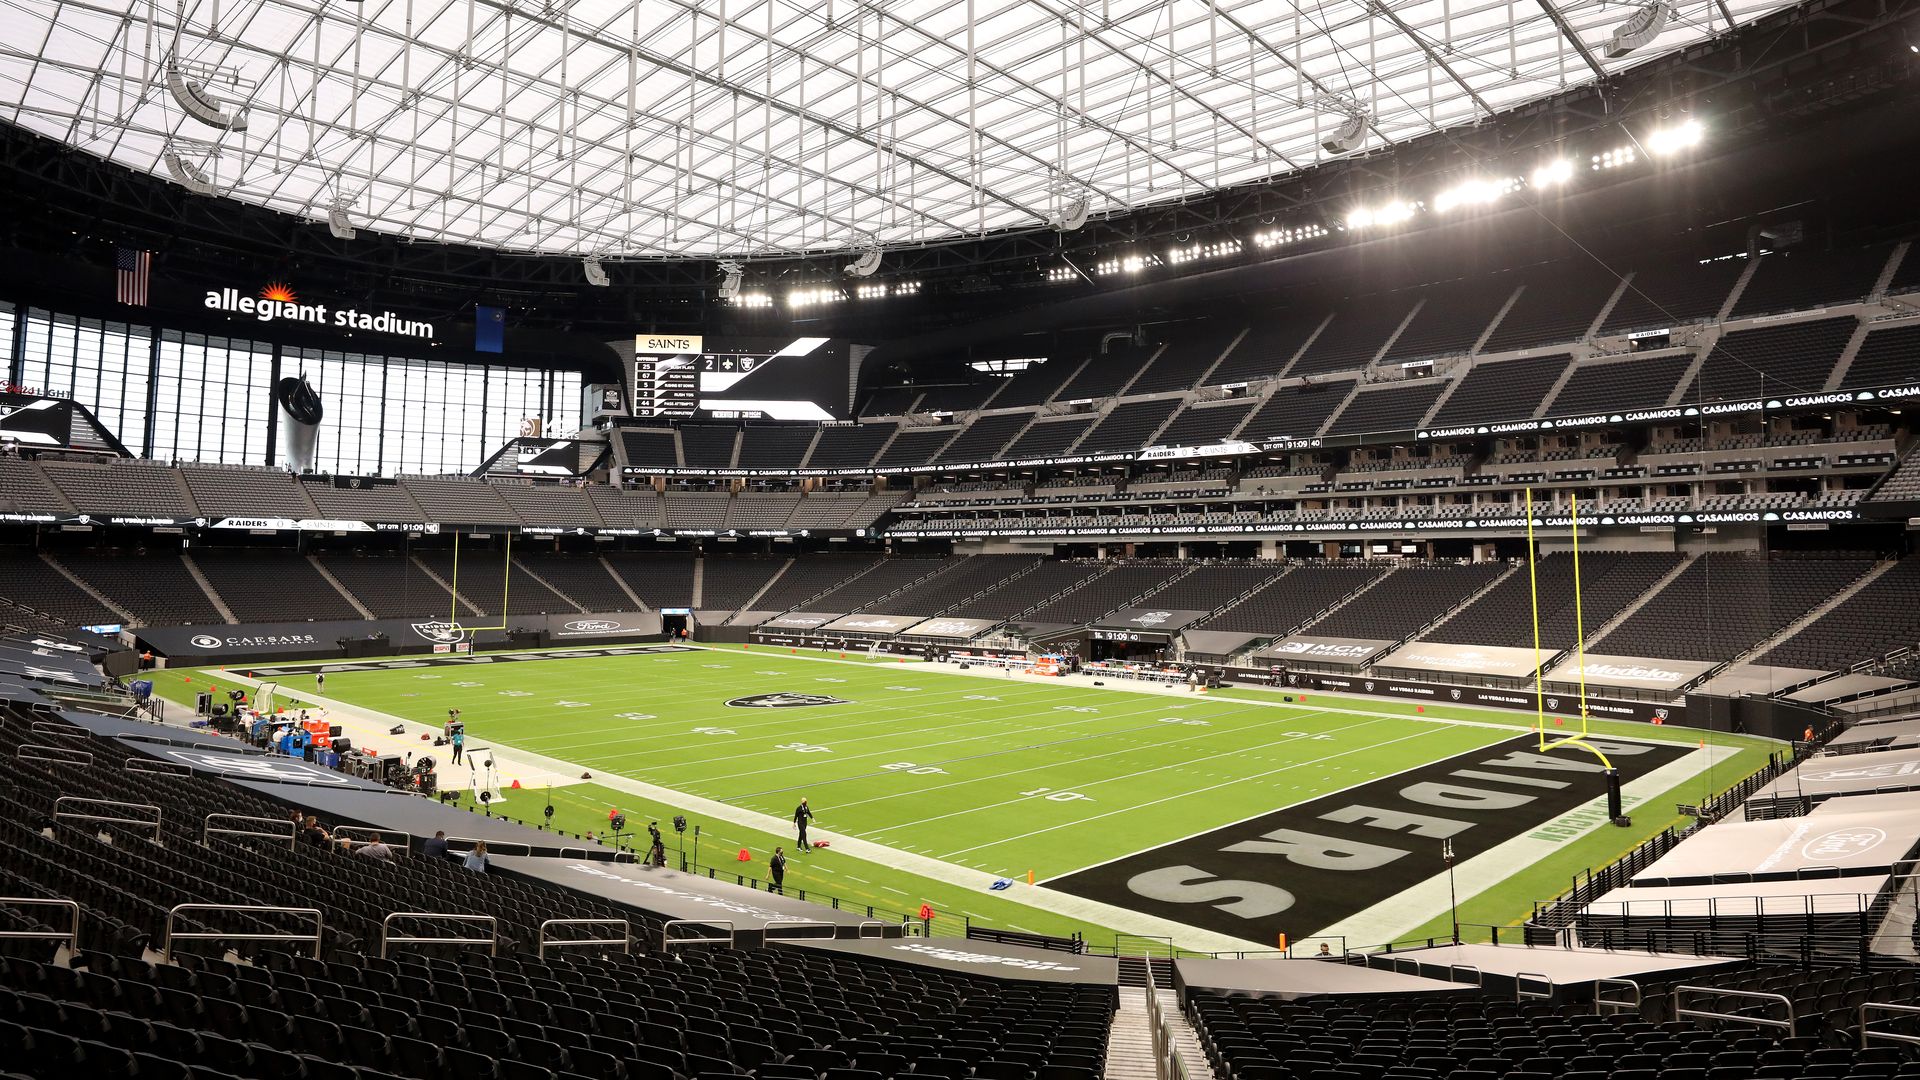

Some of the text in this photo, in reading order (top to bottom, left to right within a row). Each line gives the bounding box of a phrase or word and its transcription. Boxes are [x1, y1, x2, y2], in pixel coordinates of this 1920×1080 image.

[205, 287, 434, 339] allegiant stadium
[648, 339, 690, 349] SAINTS
[706, 360, 713, 369] 2
[37, 388, 71, 399] LGHT
[1785, 393, 1852, 407] CASAMIGOS
[1702, 401, 1762, 414] CASAMIGOS
[1626, 408, 1681, 421] CASAMIGOS
[1556, 416, 1606, 427] CASAMIGOS
[1491, 422, 1538, 432] CASAMIGOS
[1431, 428, 1475, 437] CASAMIGOS
[1287, 441, 1307, 449] 91:09
[1618, 515, 1674, 524] CASAMIGOS
[1696, 513, 1759, 522] CASAMIGOS
[1783, 510, 1852, 521] CASAMIGOS
[1418, 520, 1463, 529] CASAMIGOS
[1479, 518, 1527, 527] CASAMIGOS
[427, 524, 437, 532] 40
[226, 635, 313, 644] CAESARS
[1306, 650, 1366, 658] RESORTS
[1313, 644, 1374, 654] MGM
[879, 762, 946, 775] 20
[1020, 788, 1086, 802] 10
[1126, 738, 1656, 920] RAIDERS
[1527, 808, 1609, 842] RACISM
